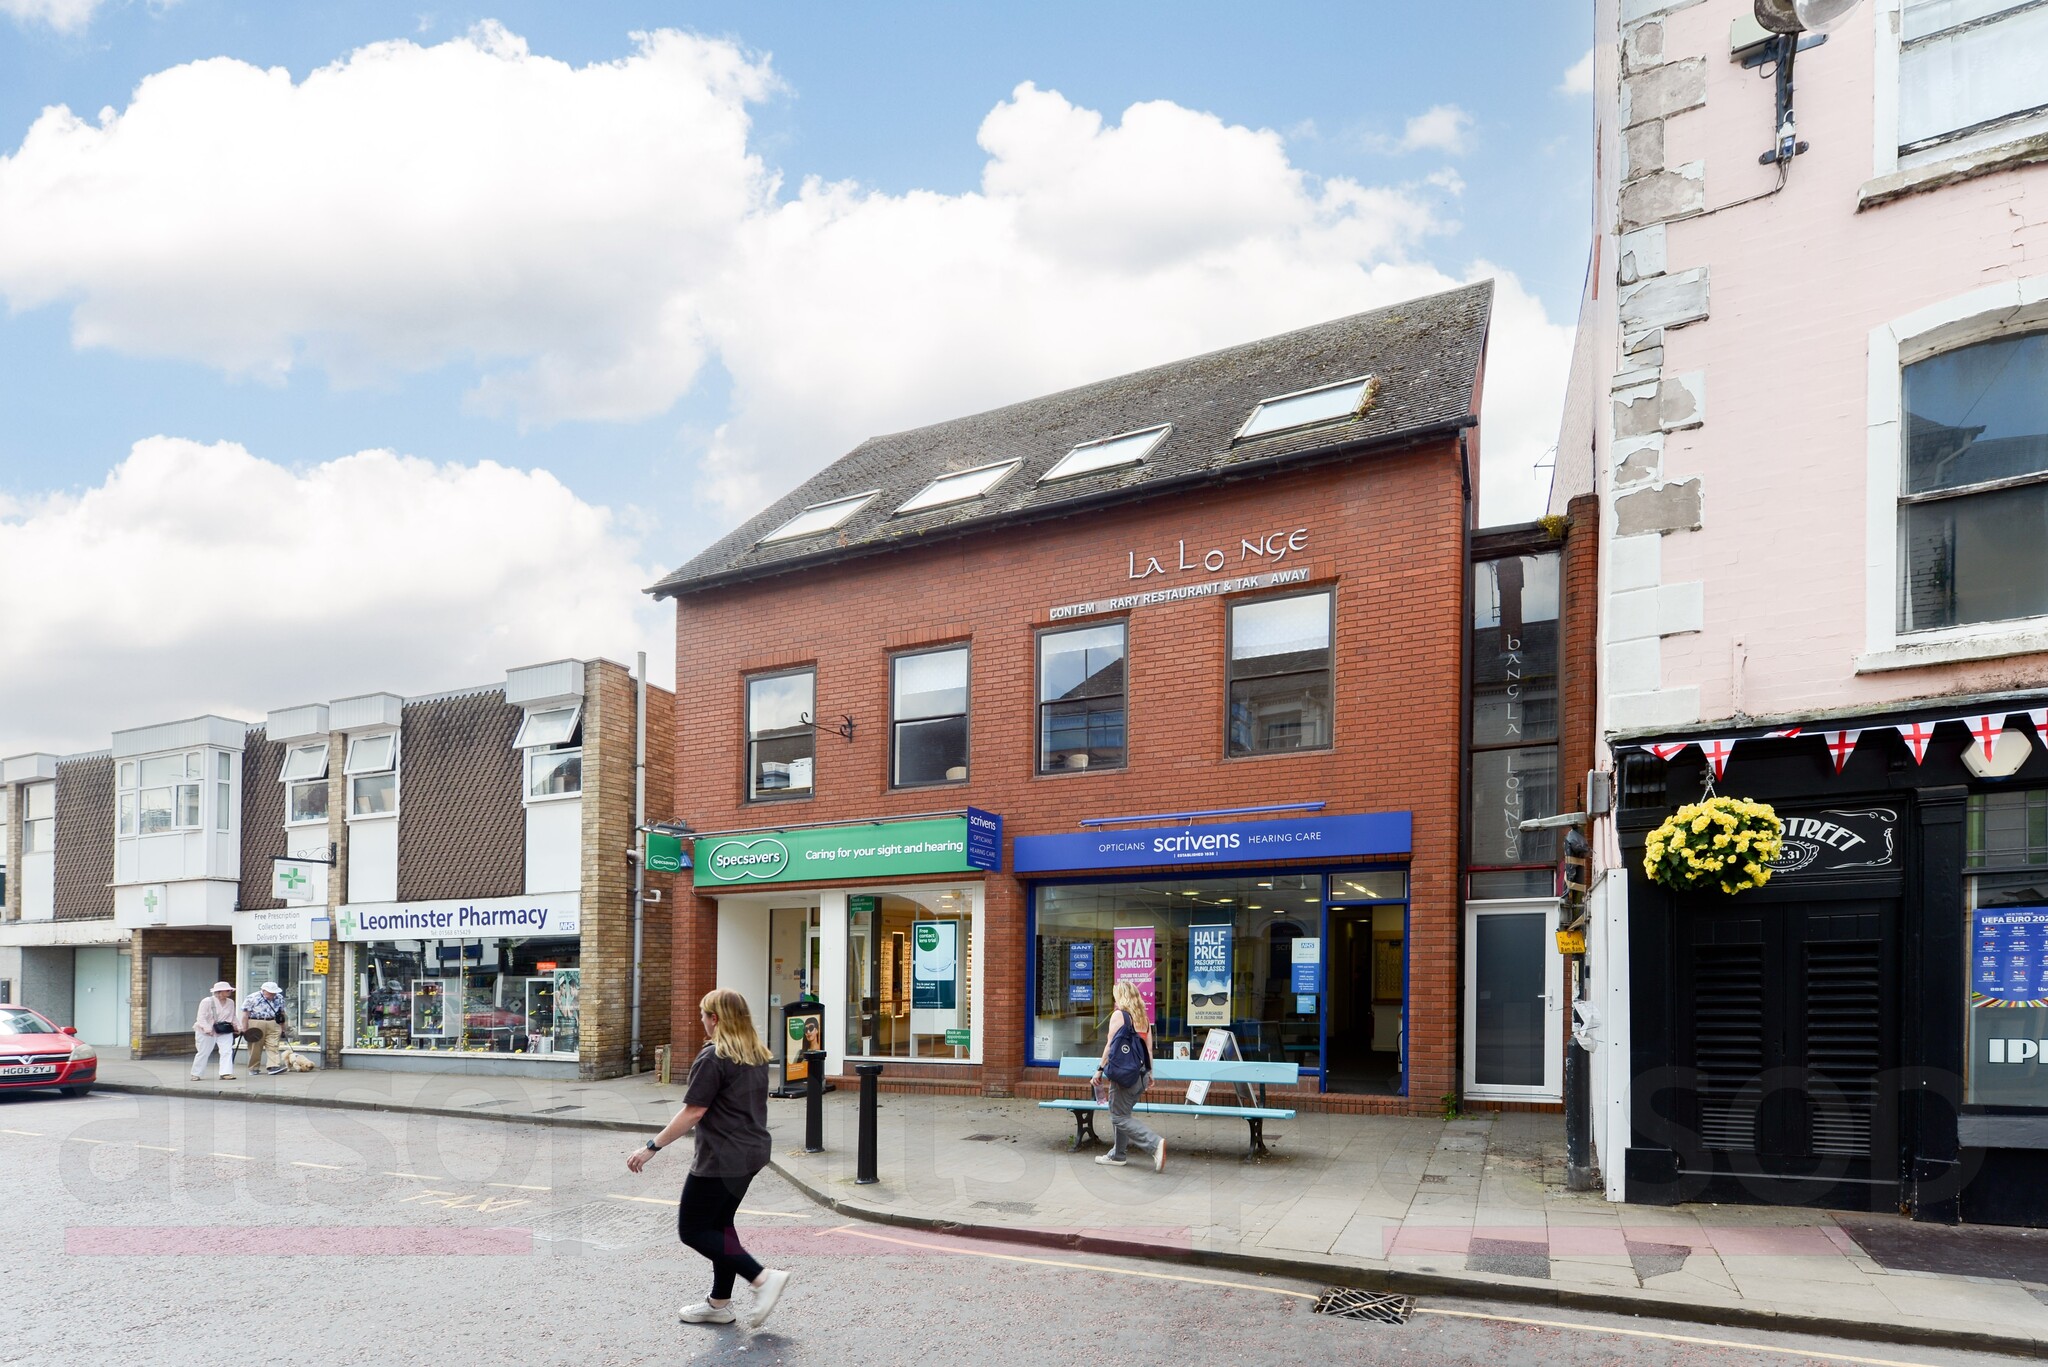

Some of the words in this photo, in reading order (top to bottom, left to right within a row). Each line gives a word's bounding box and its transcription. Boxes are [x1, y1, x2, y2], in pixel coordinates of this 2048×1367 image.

[1110, 596, 1140, 609] RARY
[1143, 583, 1221, 604] RESTAURANT
[1223, 581, 1232, 591] &
[1270, 569, 1309, 584] AWAY
[970, 815, 996, 831] scrivens
[973, 834, 993, 844] OPTICIANS
[1099, 842, 1145, 852] OPTICIANS
[1153, 831, 1240, 853] scrivens
[1249, 834, 1292, 844] HEARING
[1295, 831, 1322, 841] CARE
[805, 848, 836, 861] Caring
[837, 846, 852, 858] for
[853, 848, 876, 861] your
[877, 844, 901, 858] sight
[903, 842, 923, 854] and
[924, 840, 964, 853] hearing
[970, 847, 986, 856] HEARING
[986, 850, 996, 858] CARE
[1787, 850, 1800, 860] 31
[653, 858, 677, 867] Specsavers
[716, 851, 780, 868] Specsavers
[268, 912, 300, 920] Prescription
[360, 908, 454, 930] Leominster
[459, 906, 548, 930] Pharmacy
[1981, 916, 2005, 924] UEFA
[2006, 915, 2032, 923] EURO
[258, 923, 284, 931] Collection
[286, 922, 297, 930] and
[560, 921, 575, 931] NHS
[256, 934, 278, 942] Delivery
[279, 933, 299, 941] Service
[1194, 930, 1227, 946] HALF
[1116, 938, 1153, 959] STAY
[1194, 945, 1226, 960] PRICE
[1116, 959, 1153, 969] CONNECTED
[3, 1067, 30, 1075] HG06
[32, 1066, 52, 1074] ZYJ
